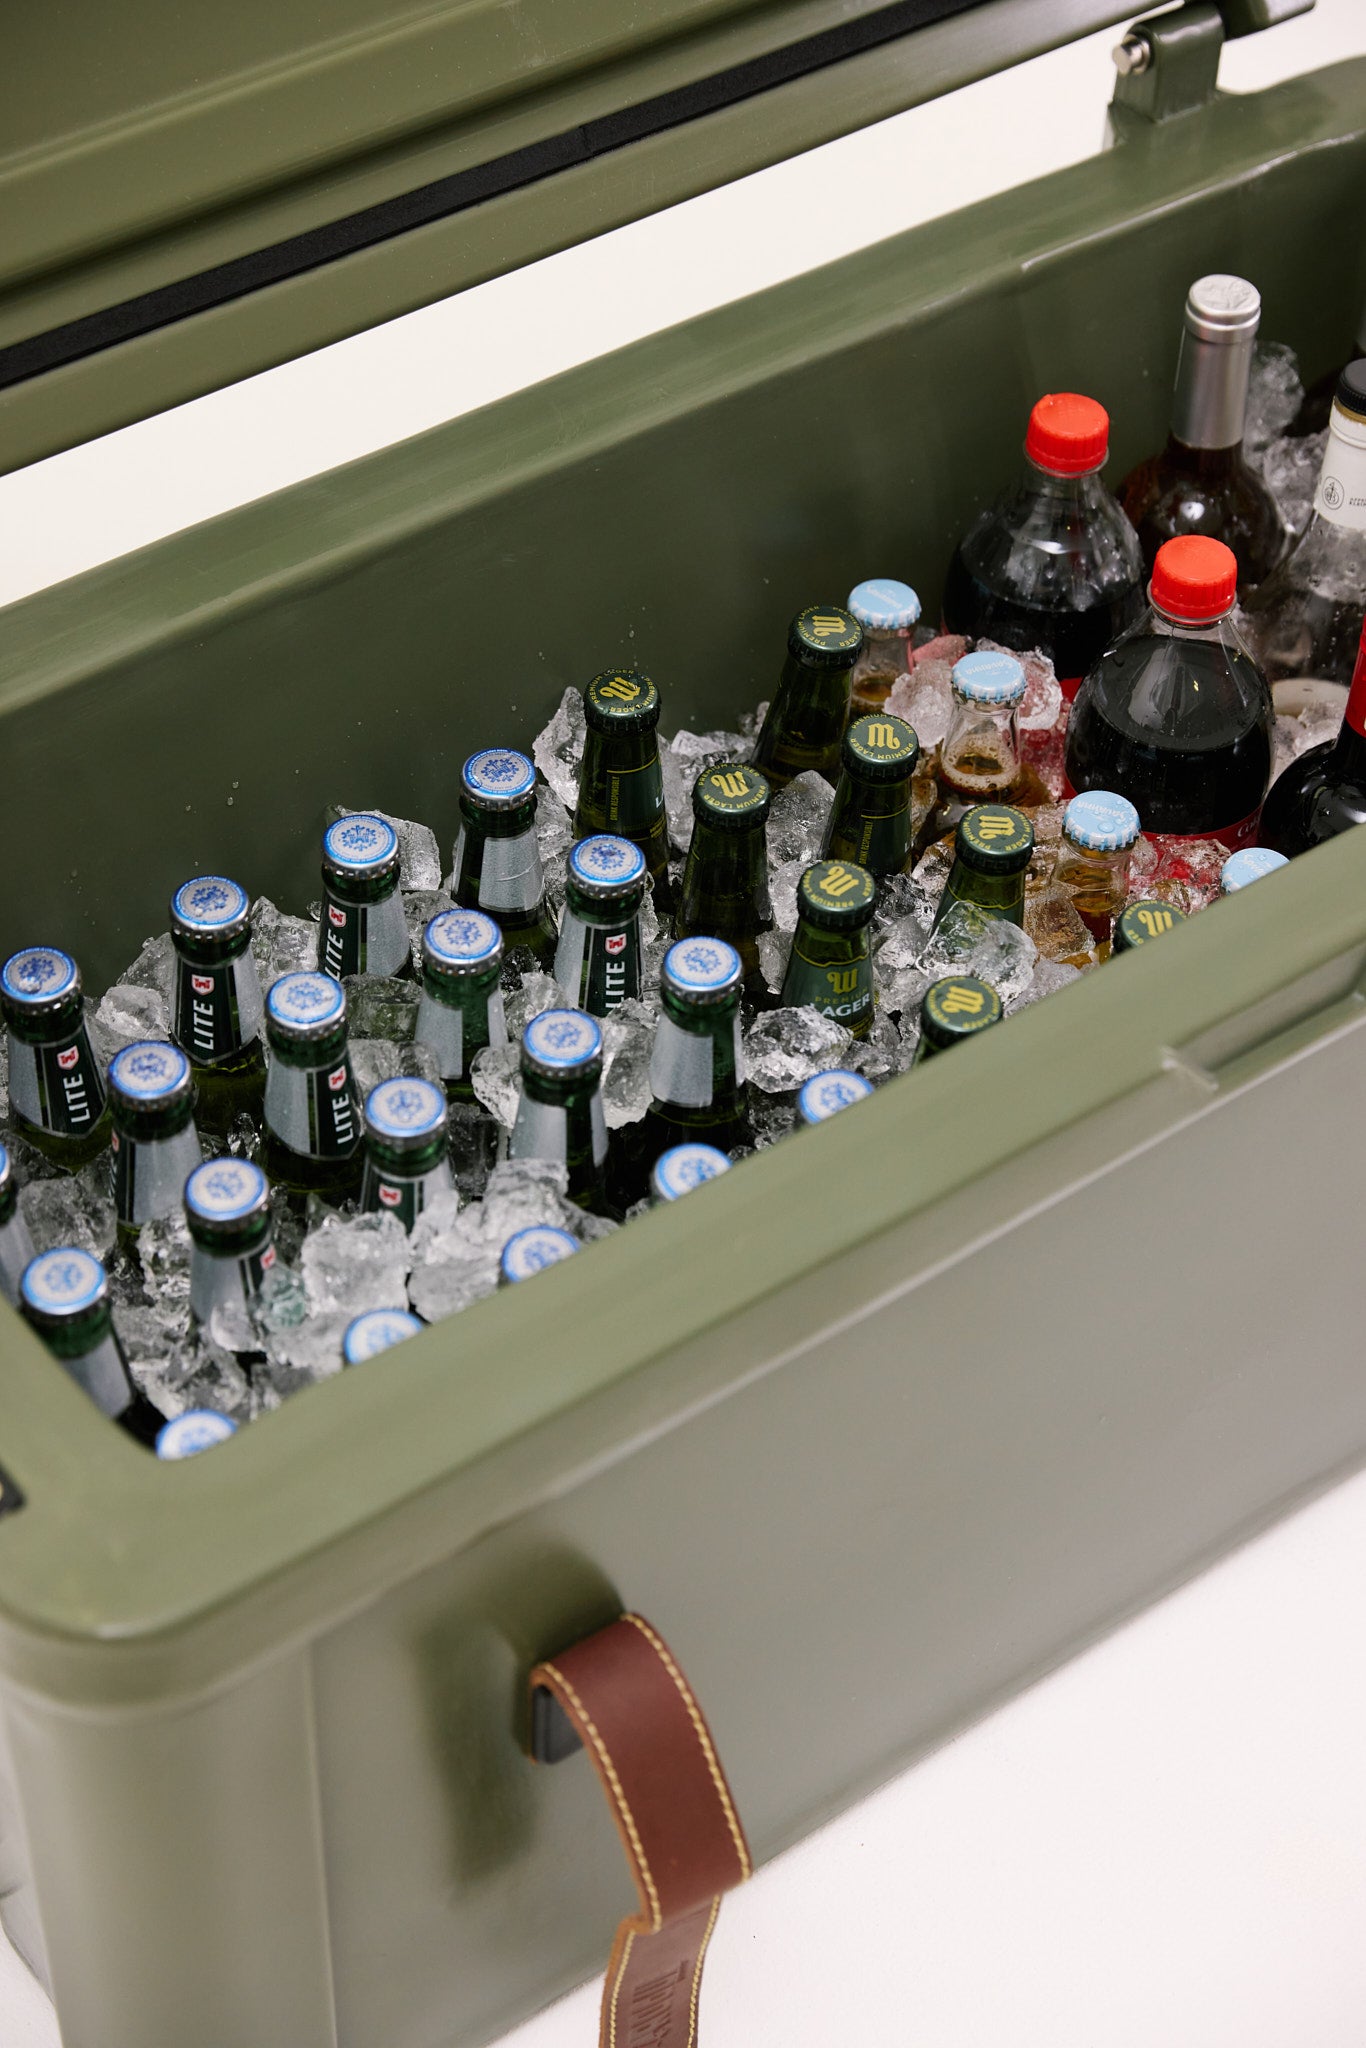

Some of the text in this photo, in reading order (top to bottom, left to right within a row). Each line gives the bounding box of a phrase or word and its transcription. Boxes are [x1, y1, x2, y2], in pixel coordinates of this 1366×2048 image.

[839, 630, 860, 647] LAGER
[589, 675, 603, 704] PREMIUM
[643, 677, 656, 707] PREMIUM
[852, 713, 914, 735] PREMIUM LAGER
[850, 738, 914, 761] PREMIUM LAGER
[698, 763, 760, 786] PREMIUM LAGER
[703, 785, 767, 809] PREMIUM LAGER
[963, 821, 991, 850] PREMIUM
[1002, 805, 1031, 851] PREMIUM LAGER
[323, 928, 344, 982] LITE
[605, 961, 625, 1009] LITE
[815, 986, 868, 1005] PREMIUM
[193, 999, 214, 1050] LITE
[63, 1073, 90, 1124] LITE
[332, 1092, 354, 1145] LITE
